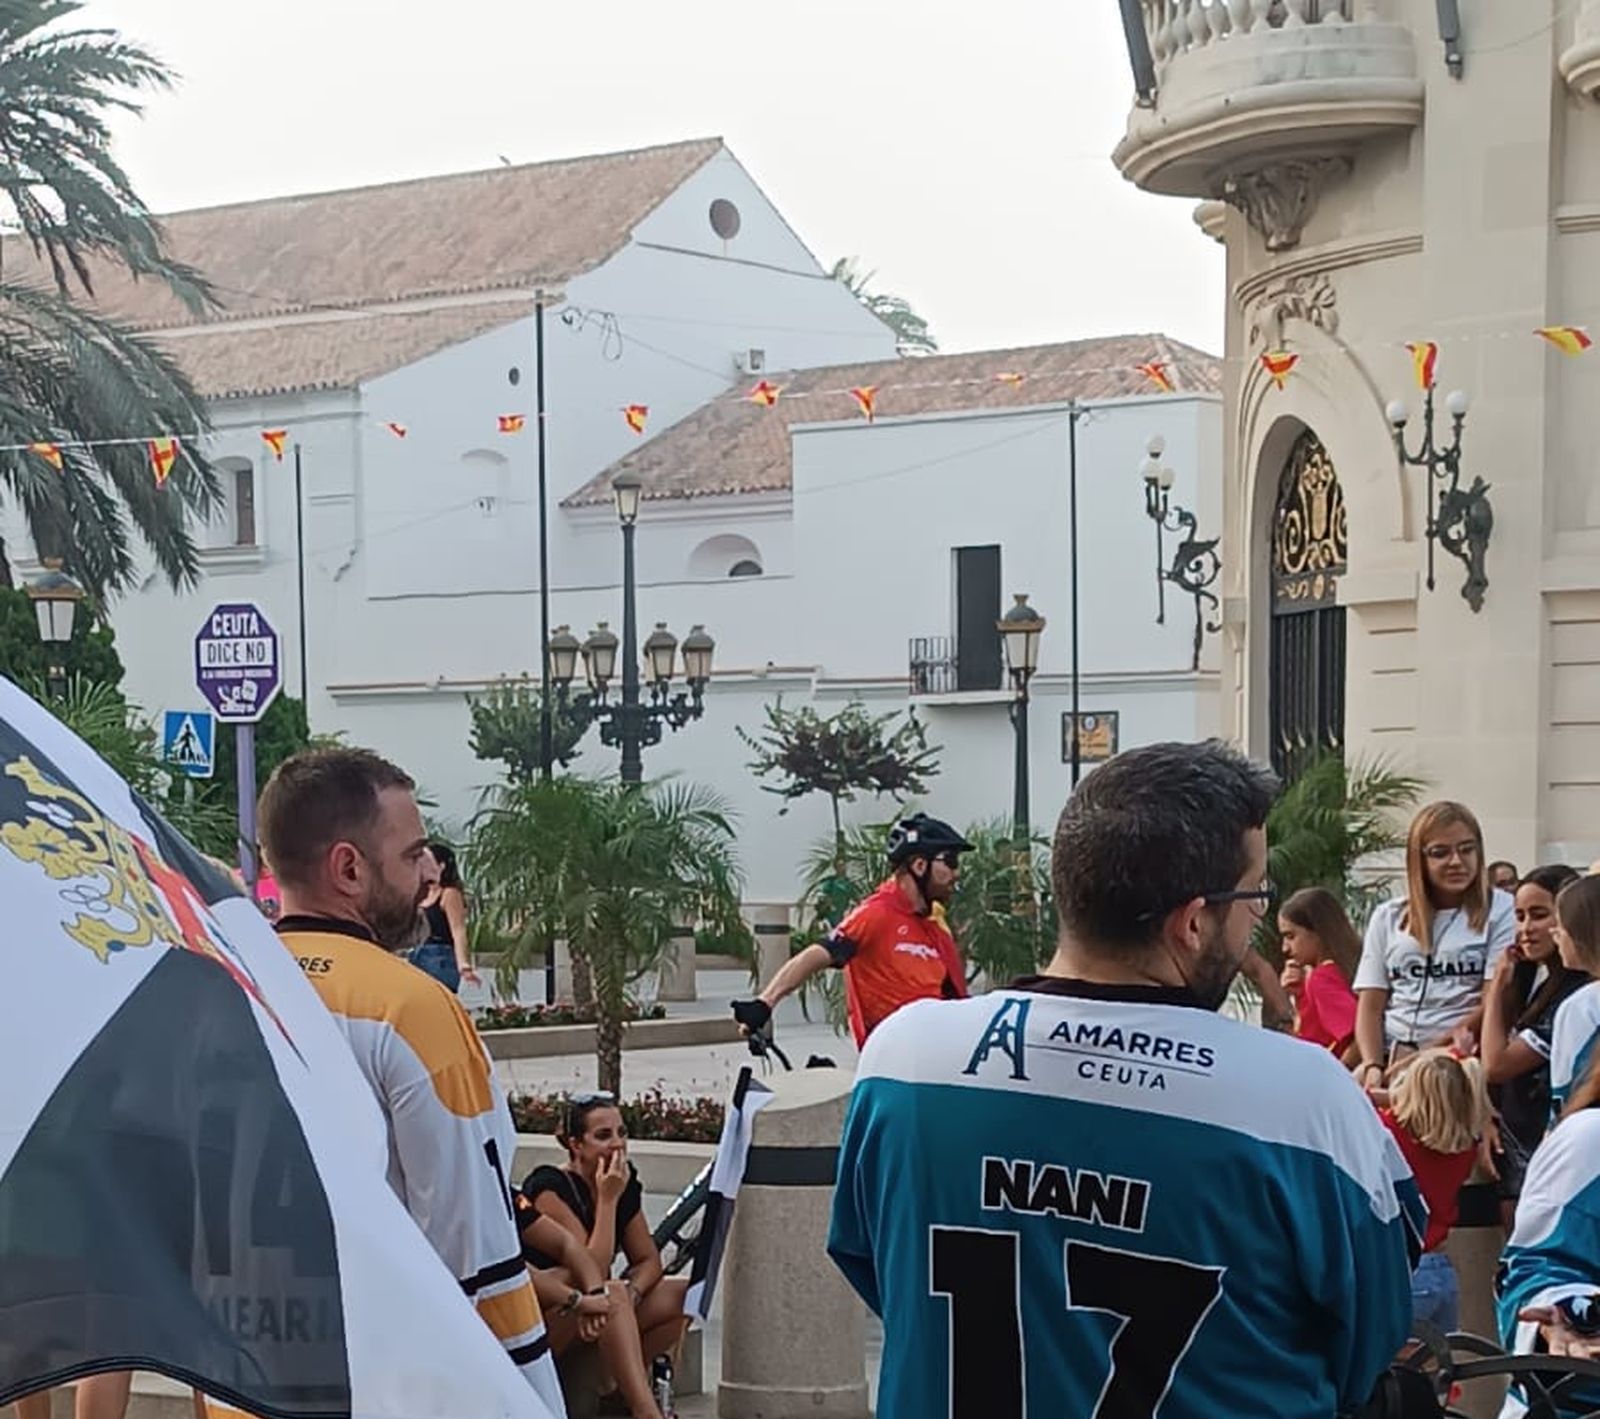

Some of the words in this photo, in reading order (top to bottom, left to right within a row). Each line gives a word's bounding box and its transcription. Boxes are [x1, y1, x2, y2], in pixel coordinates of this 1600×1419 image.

[212, 612, 259, 636] CEUTA
[207, 641, 240, 663] DICE
[246, 641, 265, 663] NO
[1049, 1021, 1215, 1068] AMARRES
[1077, 1060, 1166, 1091] CEUTA
[981, 1156, 1151, 1233] NANI
